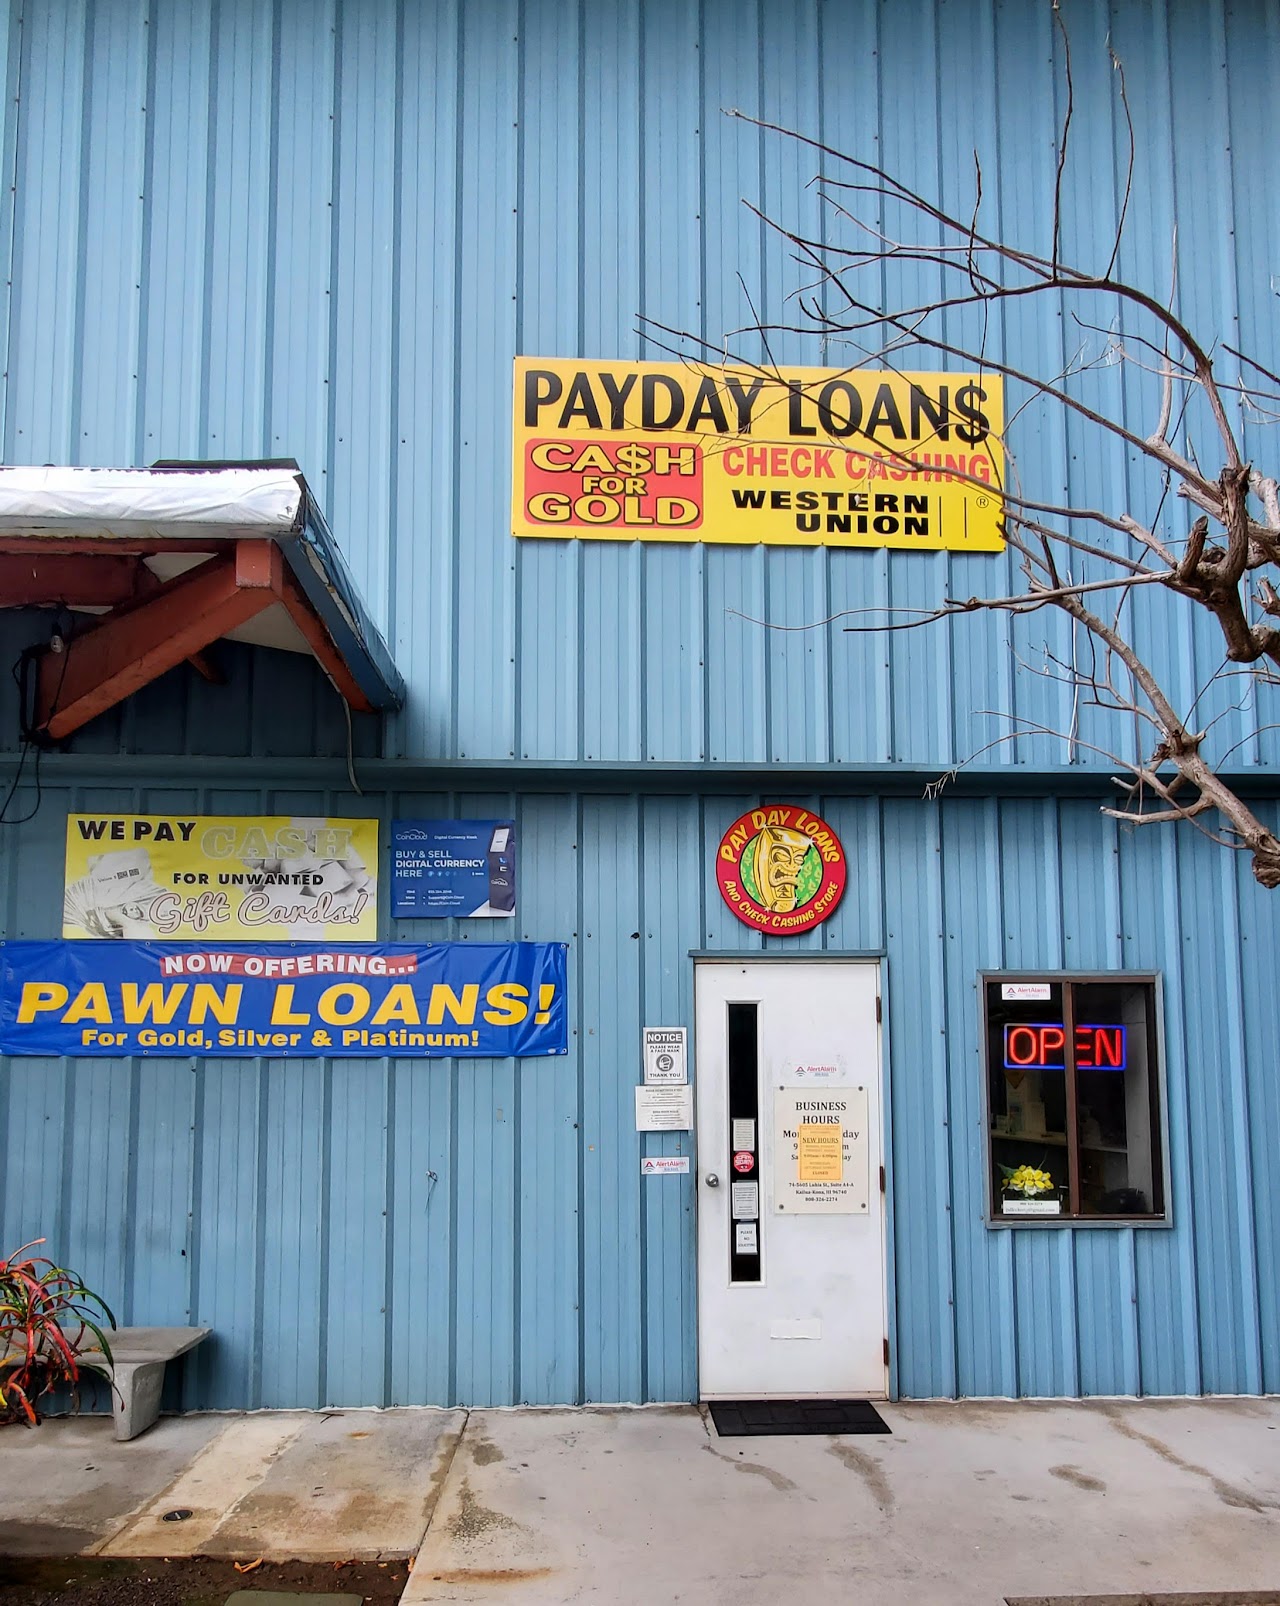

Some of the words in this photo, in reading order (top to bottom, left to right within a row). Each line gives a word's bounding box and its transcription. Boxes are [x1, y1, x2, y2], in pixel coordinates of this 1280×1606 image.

[524, 370, 763, 435] PAYDAY
[789, 379, 990, 450] LOAN$
[530, 442, 697, 477] CA$H
[722, 446, 836, 479] CHECK
[845, 450, 990, 484] CASHING
[582, 475, 648, 496] FOR
[527, 492, 700, 526] GOLD
[732, 489, 929, 513] WESTERN
[796, 513, 929, 536] UNION
[78, 820, 125, 840] WE
[133, 821, 197, 842] PAY
[202, 826, 353, 861] CASH
[395, 850, 417, 858] BUY
[418, 850, 426, 858] &
[428, 850, 452, 858] SELL
[395, 860, 433, 868] DIGITAL
[434, 859, 485, 868] CURRENCY
[173, 873, 210, 885] FOR
[218, 873, 324, 886] UNWANTED
[395, 870, 423, 878] HERE
[149, 891, 231, 934] Gift
[237, 891, 369, 927] Cards!
[165, 954, 234, 974] NOW
[244, 954, 415, 977] OFFERING...
[16, 983, 244, 1025] PAWN
[270, 983, 555, 1026] LOANS!
[81, 1029, 128, 1046] For
[137, 1029, 212, 1049] Gold,
[218, 1029, 301, 1047] Silver
[311, 1030, 332, 1047] &
[342, 1030, 479, 1047] Platinum!
[647, 1033, 682, 1042] NOTICE
[1009, 1027, 1121, 1066] OPEN
[796, 1102, 847, 1110] BUSINESS
[802, 1115, 840, 1124] HOURS
